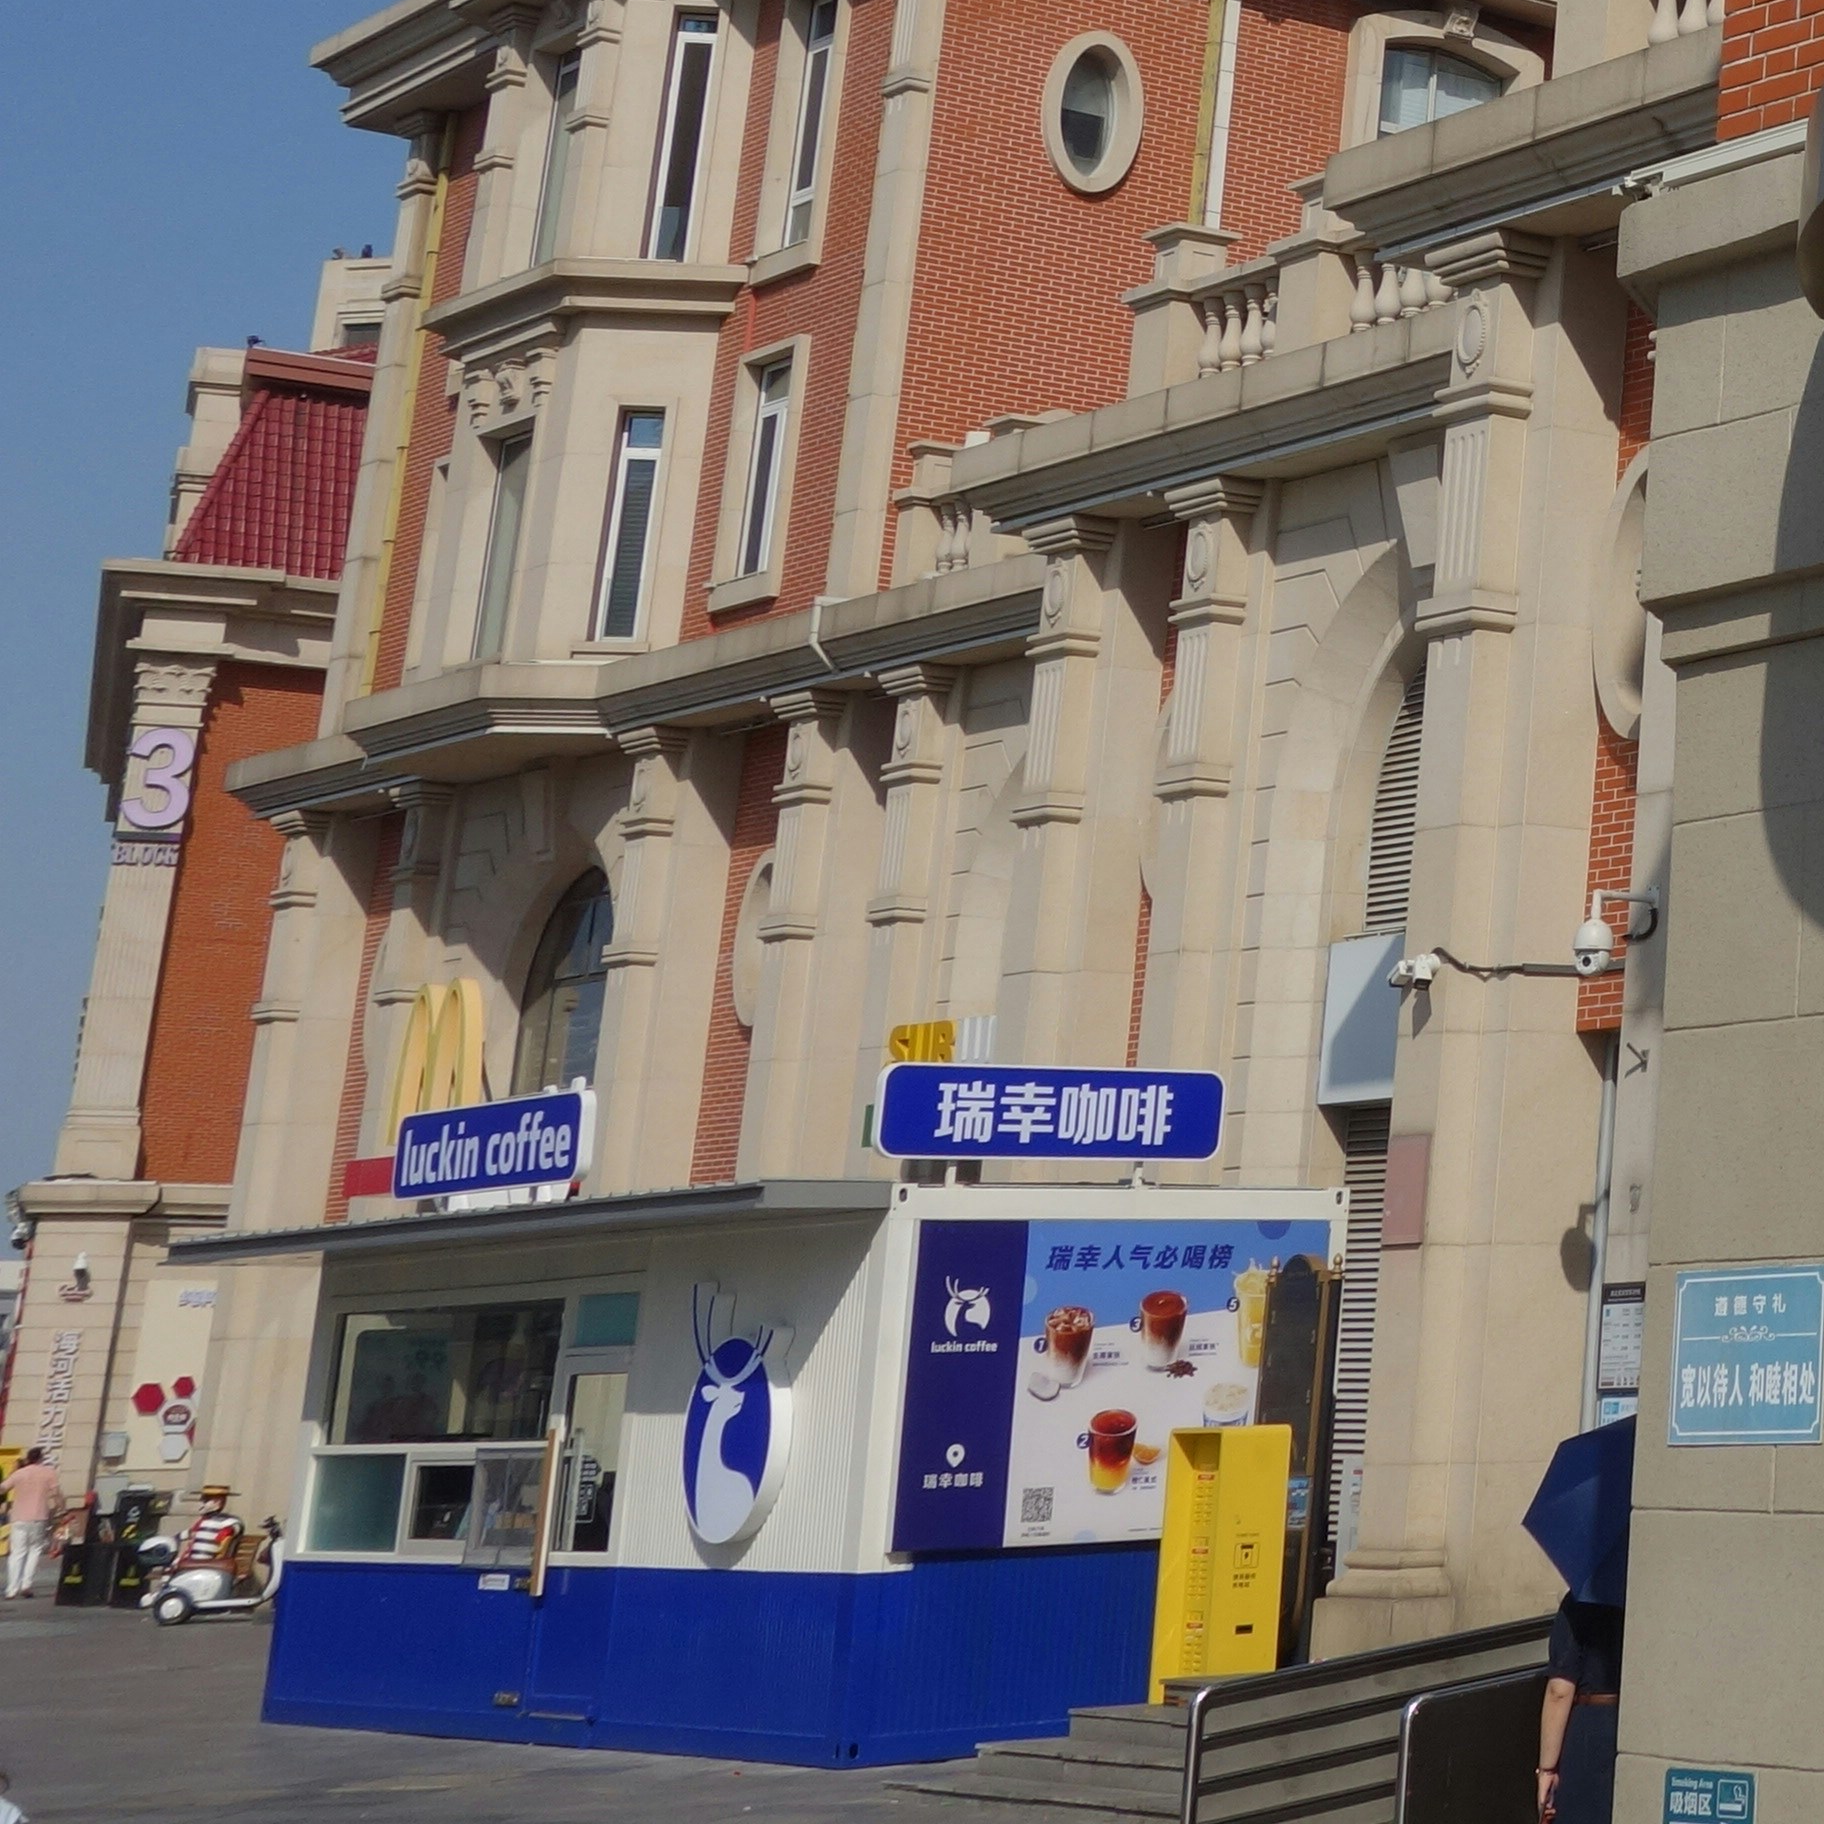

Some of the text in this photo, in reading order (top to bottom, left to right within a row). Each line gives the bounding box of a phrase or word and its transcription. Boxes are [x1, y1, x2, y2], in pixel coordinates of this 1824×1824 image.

[118, 727, 196, 829] 3
[111, 843, 180, 866] BLOCK
[933, 1080, 1174, 1146] 瑞幸咖啡
[400, 1110, 571, 1177] luckin coffee
[1045, 1244, 1235, 1272] 瑞幸人气必喝榜
[930, 1340, 998, 1353] luckin coffee
[1680, 1360, 1816, 1409] 宽以待人 和睦相处
[922, 1472, 984, 1490] 瑞幸咖啡
[1669, 1791, 1712, 1816] 吸烟区
